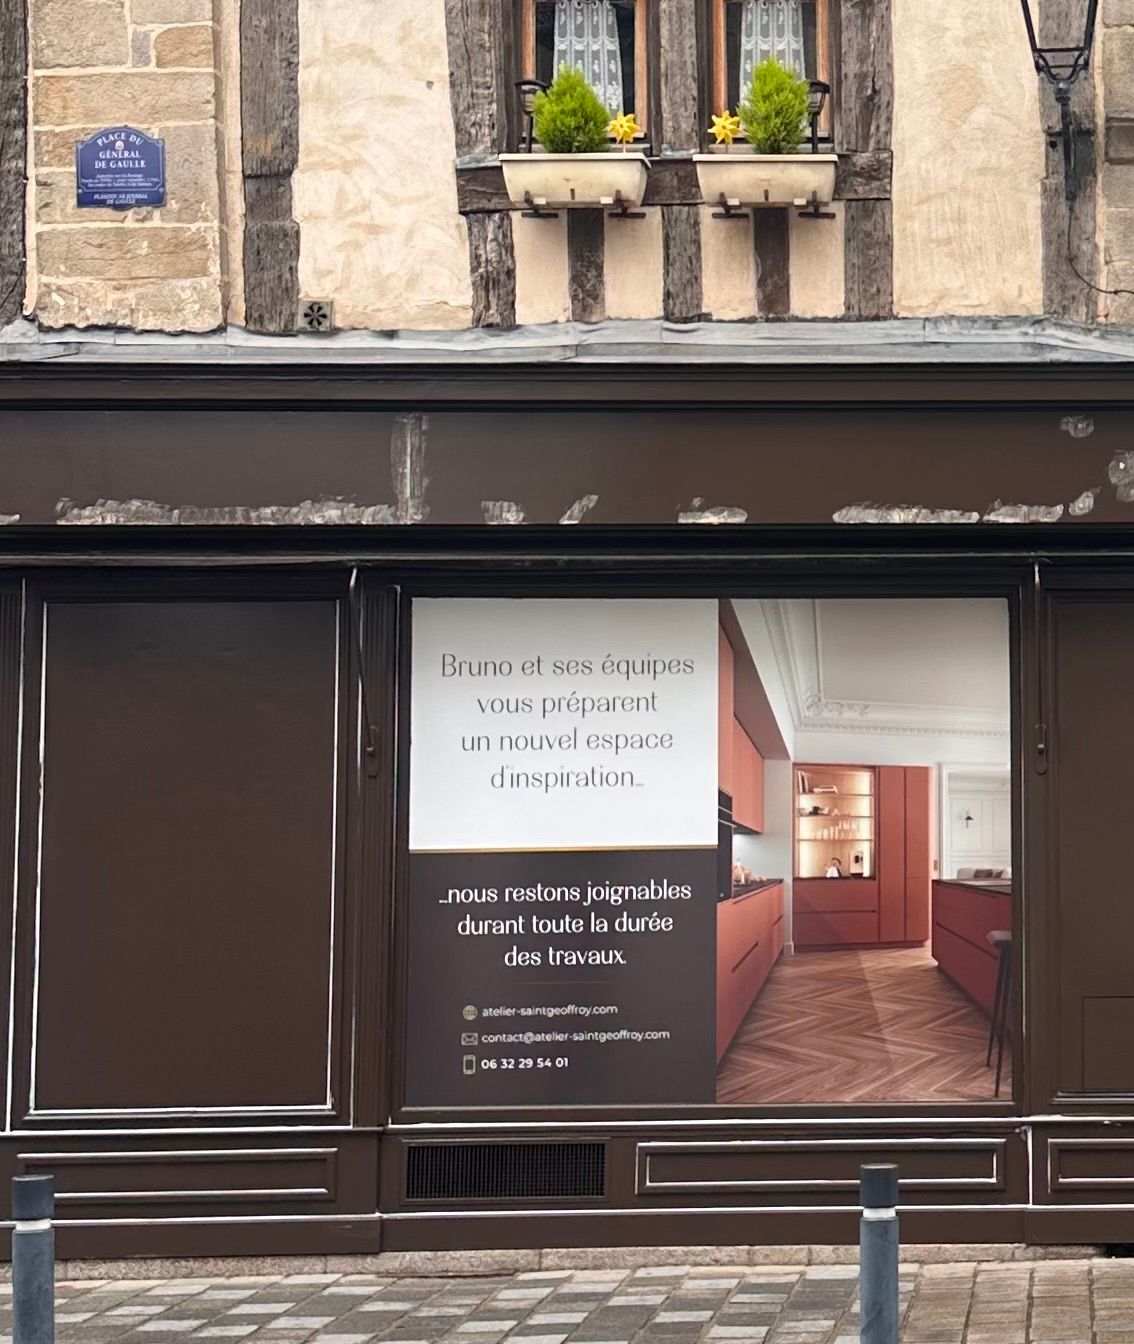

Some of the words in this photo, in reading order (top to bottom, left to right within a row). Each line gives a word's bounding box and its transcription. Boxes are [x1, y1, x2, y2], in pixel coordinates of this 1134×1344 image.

[96, 132, 126, 146] PLACE
[129, 134, 144, 145] DU
[99, 149, 141, 159] GÉNÉRAL
[94, 160, 108, 169] DE
[109, 159, 146, 168] GAULLE
[441, 652, 513, 677] Bruno
[521, 655, 544, 676] et
[552, 658, 593, 676] ses
[601, 652, 695, 681] équipes
[477, 696, 533, 714] vous
[542, 691, 658, 719] préparent
[461, 734, 490, 752] un
[500, 726, 577, 751] nouvel
[586, 732, 673, 755] espace
[504, 882, 581, 903] restons
[582, 878, 692, 906] joignables
[457, 913, 525, 936] durant
[532, 914, 584, 934] toute
[590, 911, 609, 933] la
[614, 911, 674, 932] durée
[504, 945, 542, 967] des
[482, 1004, 618, 1018] atelier-saintgeoffroy.com
[481, 1029, 671, 1044] contact@atelier-saintgeoffroy.com
[481, 1058, 497, 1069] 06
[500, 1058, 515, 1069] 32
[518, 1058, 533, 1069] 29
[536, 1057, 552, 1068] 54
[555, 1057, 569, 1068] 01
